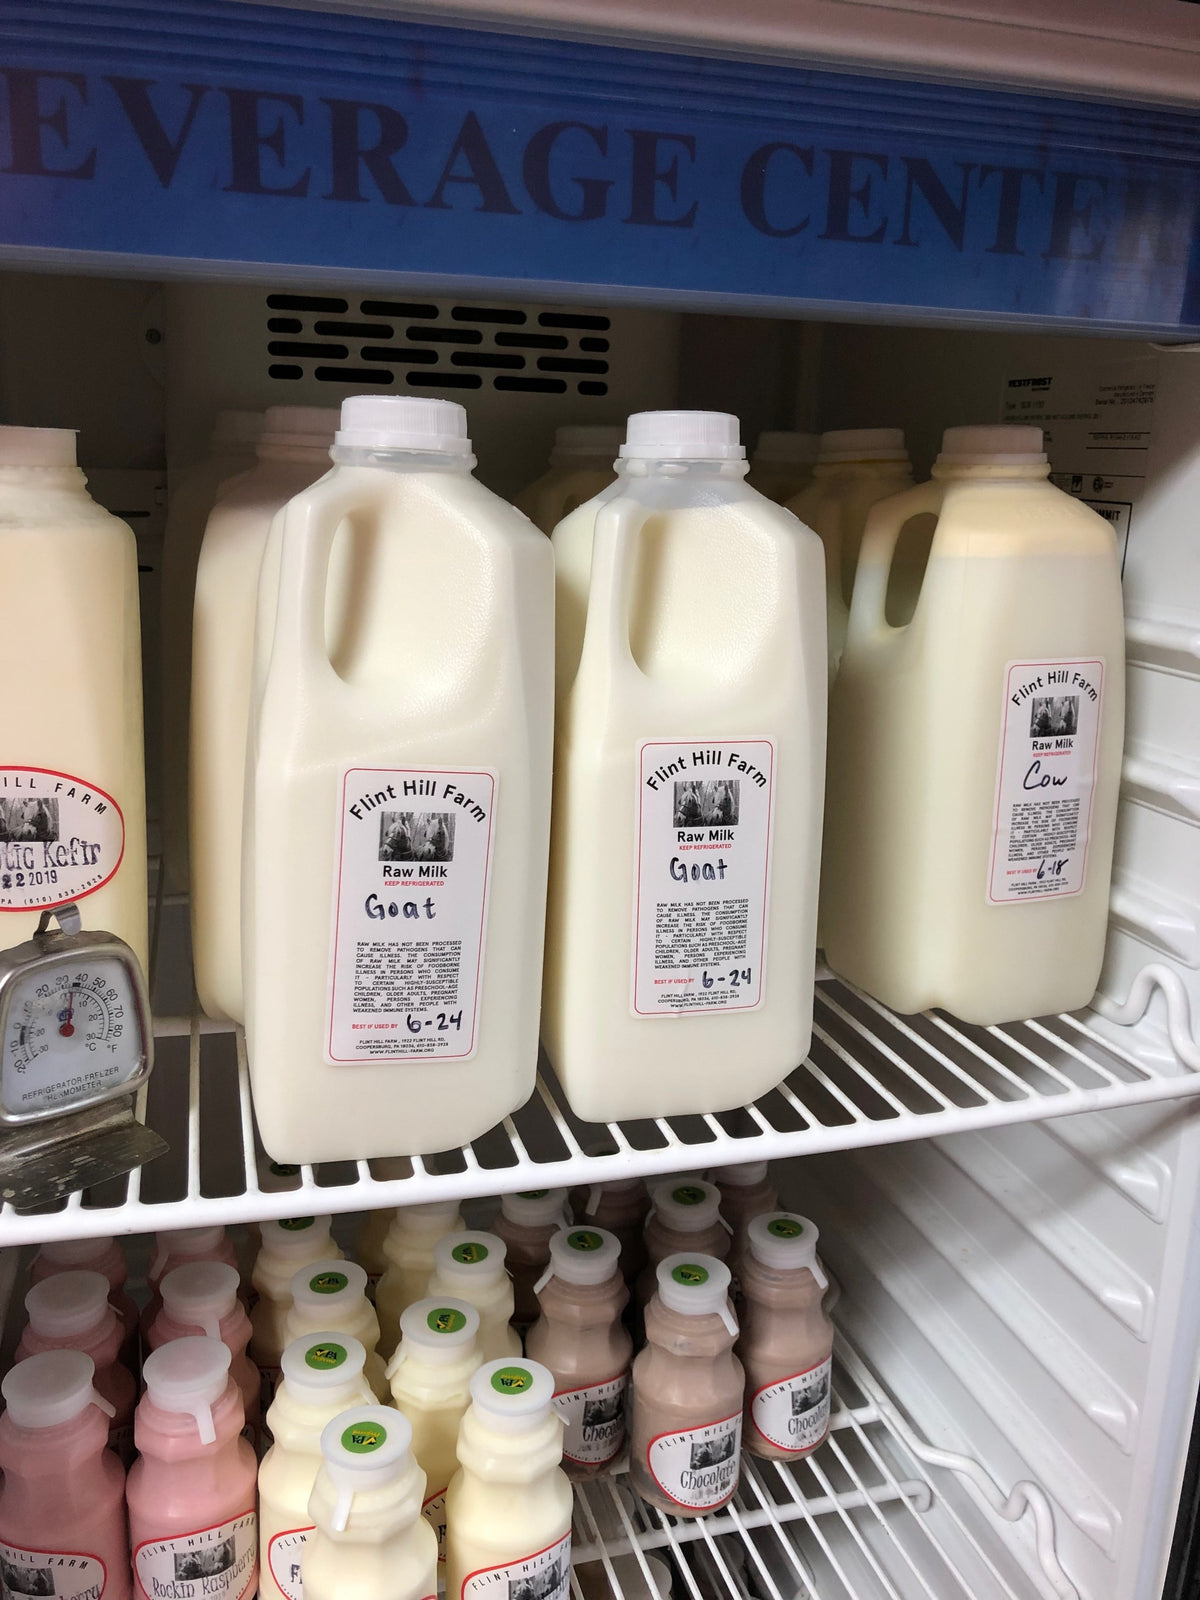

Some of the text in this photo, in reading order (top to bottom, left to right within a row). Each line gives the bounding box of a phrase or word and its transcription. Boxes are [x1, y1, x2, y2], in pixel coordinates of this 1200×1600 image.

[0, 66, 698, 230] EVERAGE
[1012, 671, 1098, 706] Flint Hill Farm
[1032, 739, 1073, 750] Raw Milk
[647, 750, 767, 790] Flint Hill Farm
[1024, 760, 1067, 790] Cow
[55, 783, 107, 814] FARM
[349, 780, 486, 822] Flint Hill Farm
[678, 830, 734, 842] Raw Milk
[0, 837, 101, 871] tic Kefir
[29, 870, 58, 886] 2019
[383, 866, 448, 877] Raw Milk
[670, 857, 728, 883] Goat
[365, 893, 437, 920] Goat
[702, 968, 751, 988] 6-24
[35, 973, 124, 1038] 20 30 40 50 60 70 80
[407, 1010, 462, 1033] 6-24
[760, 1383, 792, 1403] FLINT
[658, 1423, 729, 1450] FLINT HILL
[141, 1531, 222, 1560] FLINT HILL
[48, 1558, 88, 1570] FARM
[472, 1553, 552, 1590] FLINT HILL
[152, 1576, 195, 1599] Rockin
